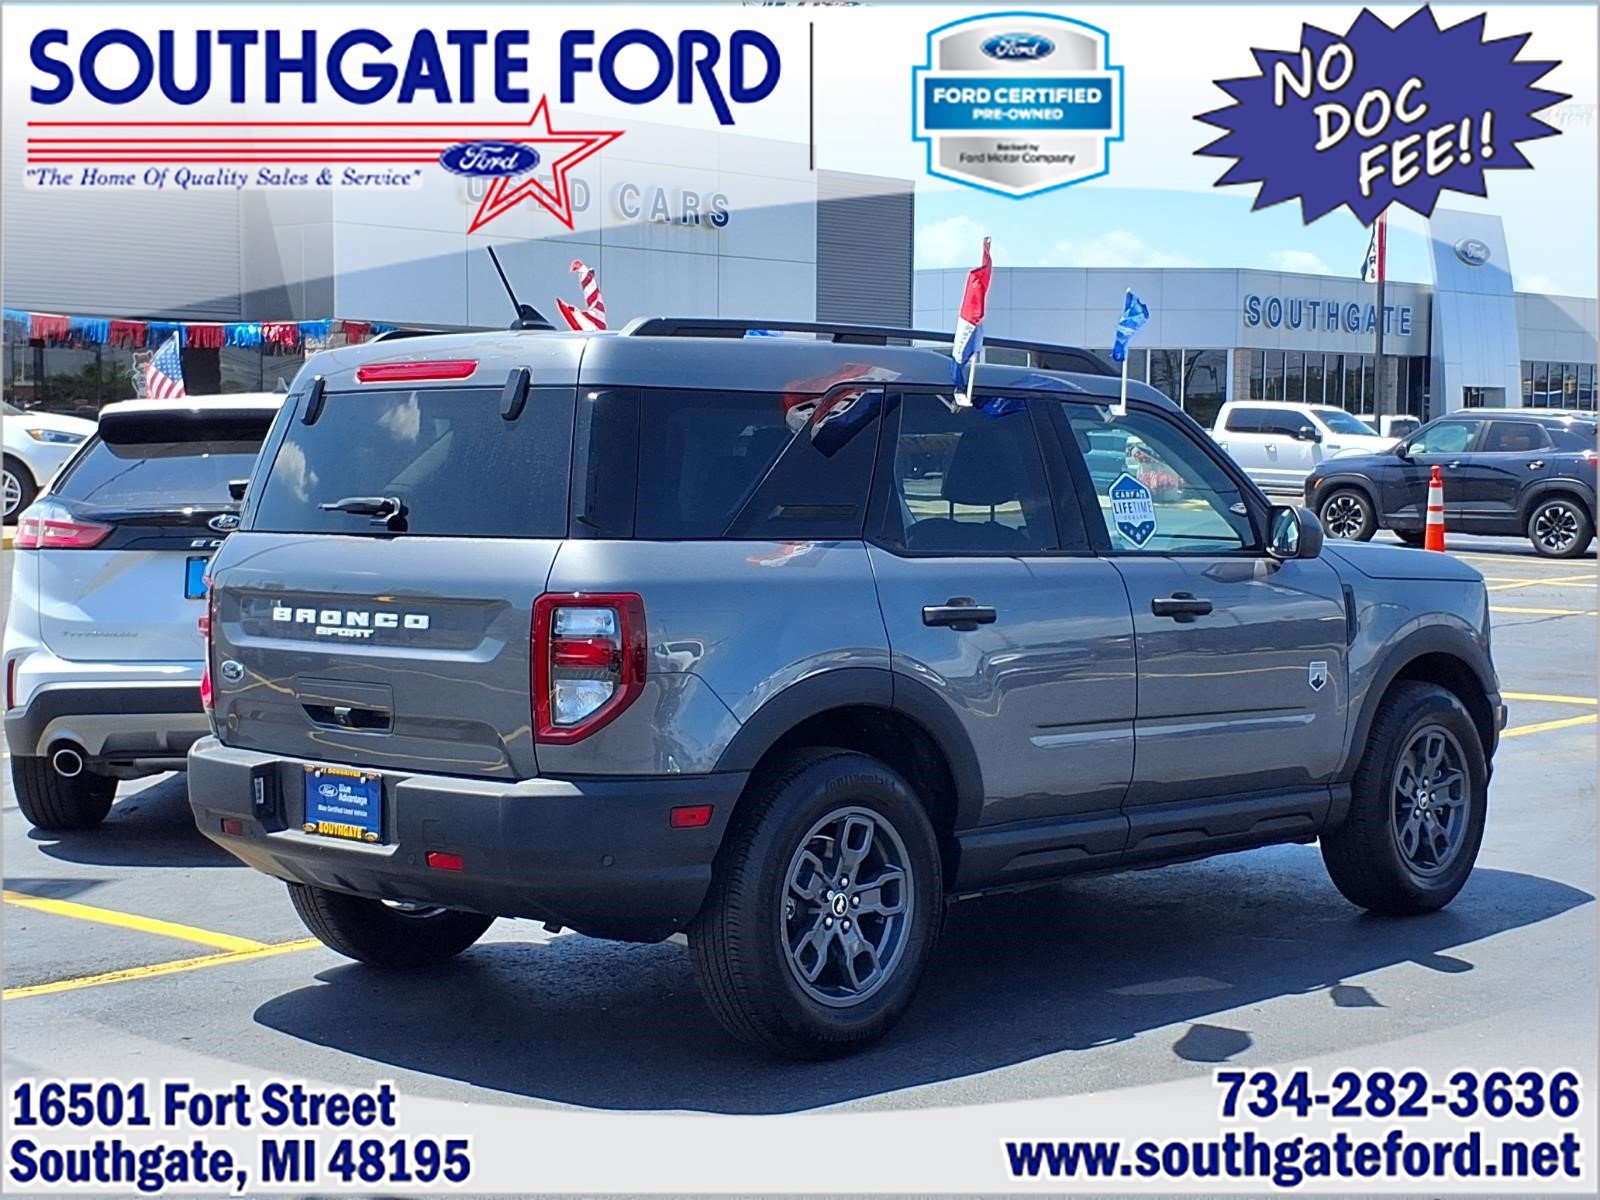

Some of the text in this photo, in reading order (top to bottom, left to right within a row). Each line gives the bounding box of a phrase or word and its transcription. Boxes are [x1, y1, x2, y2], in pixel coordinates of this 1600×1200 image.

[464, 174, 730, 229] USED CARS
[1246, 295, 1412, 335] SOUTHGATE
[1113, 501, 1153, 515] LIFETIME
[272, 607, 430, 630] BRONCO
[315, 626, 375, 638] SPORT
[338, 783, 352, 793] Blue
[338, 793, 368, 807] Advantage
[318, 822, 363, 839] SOUTHGATE
